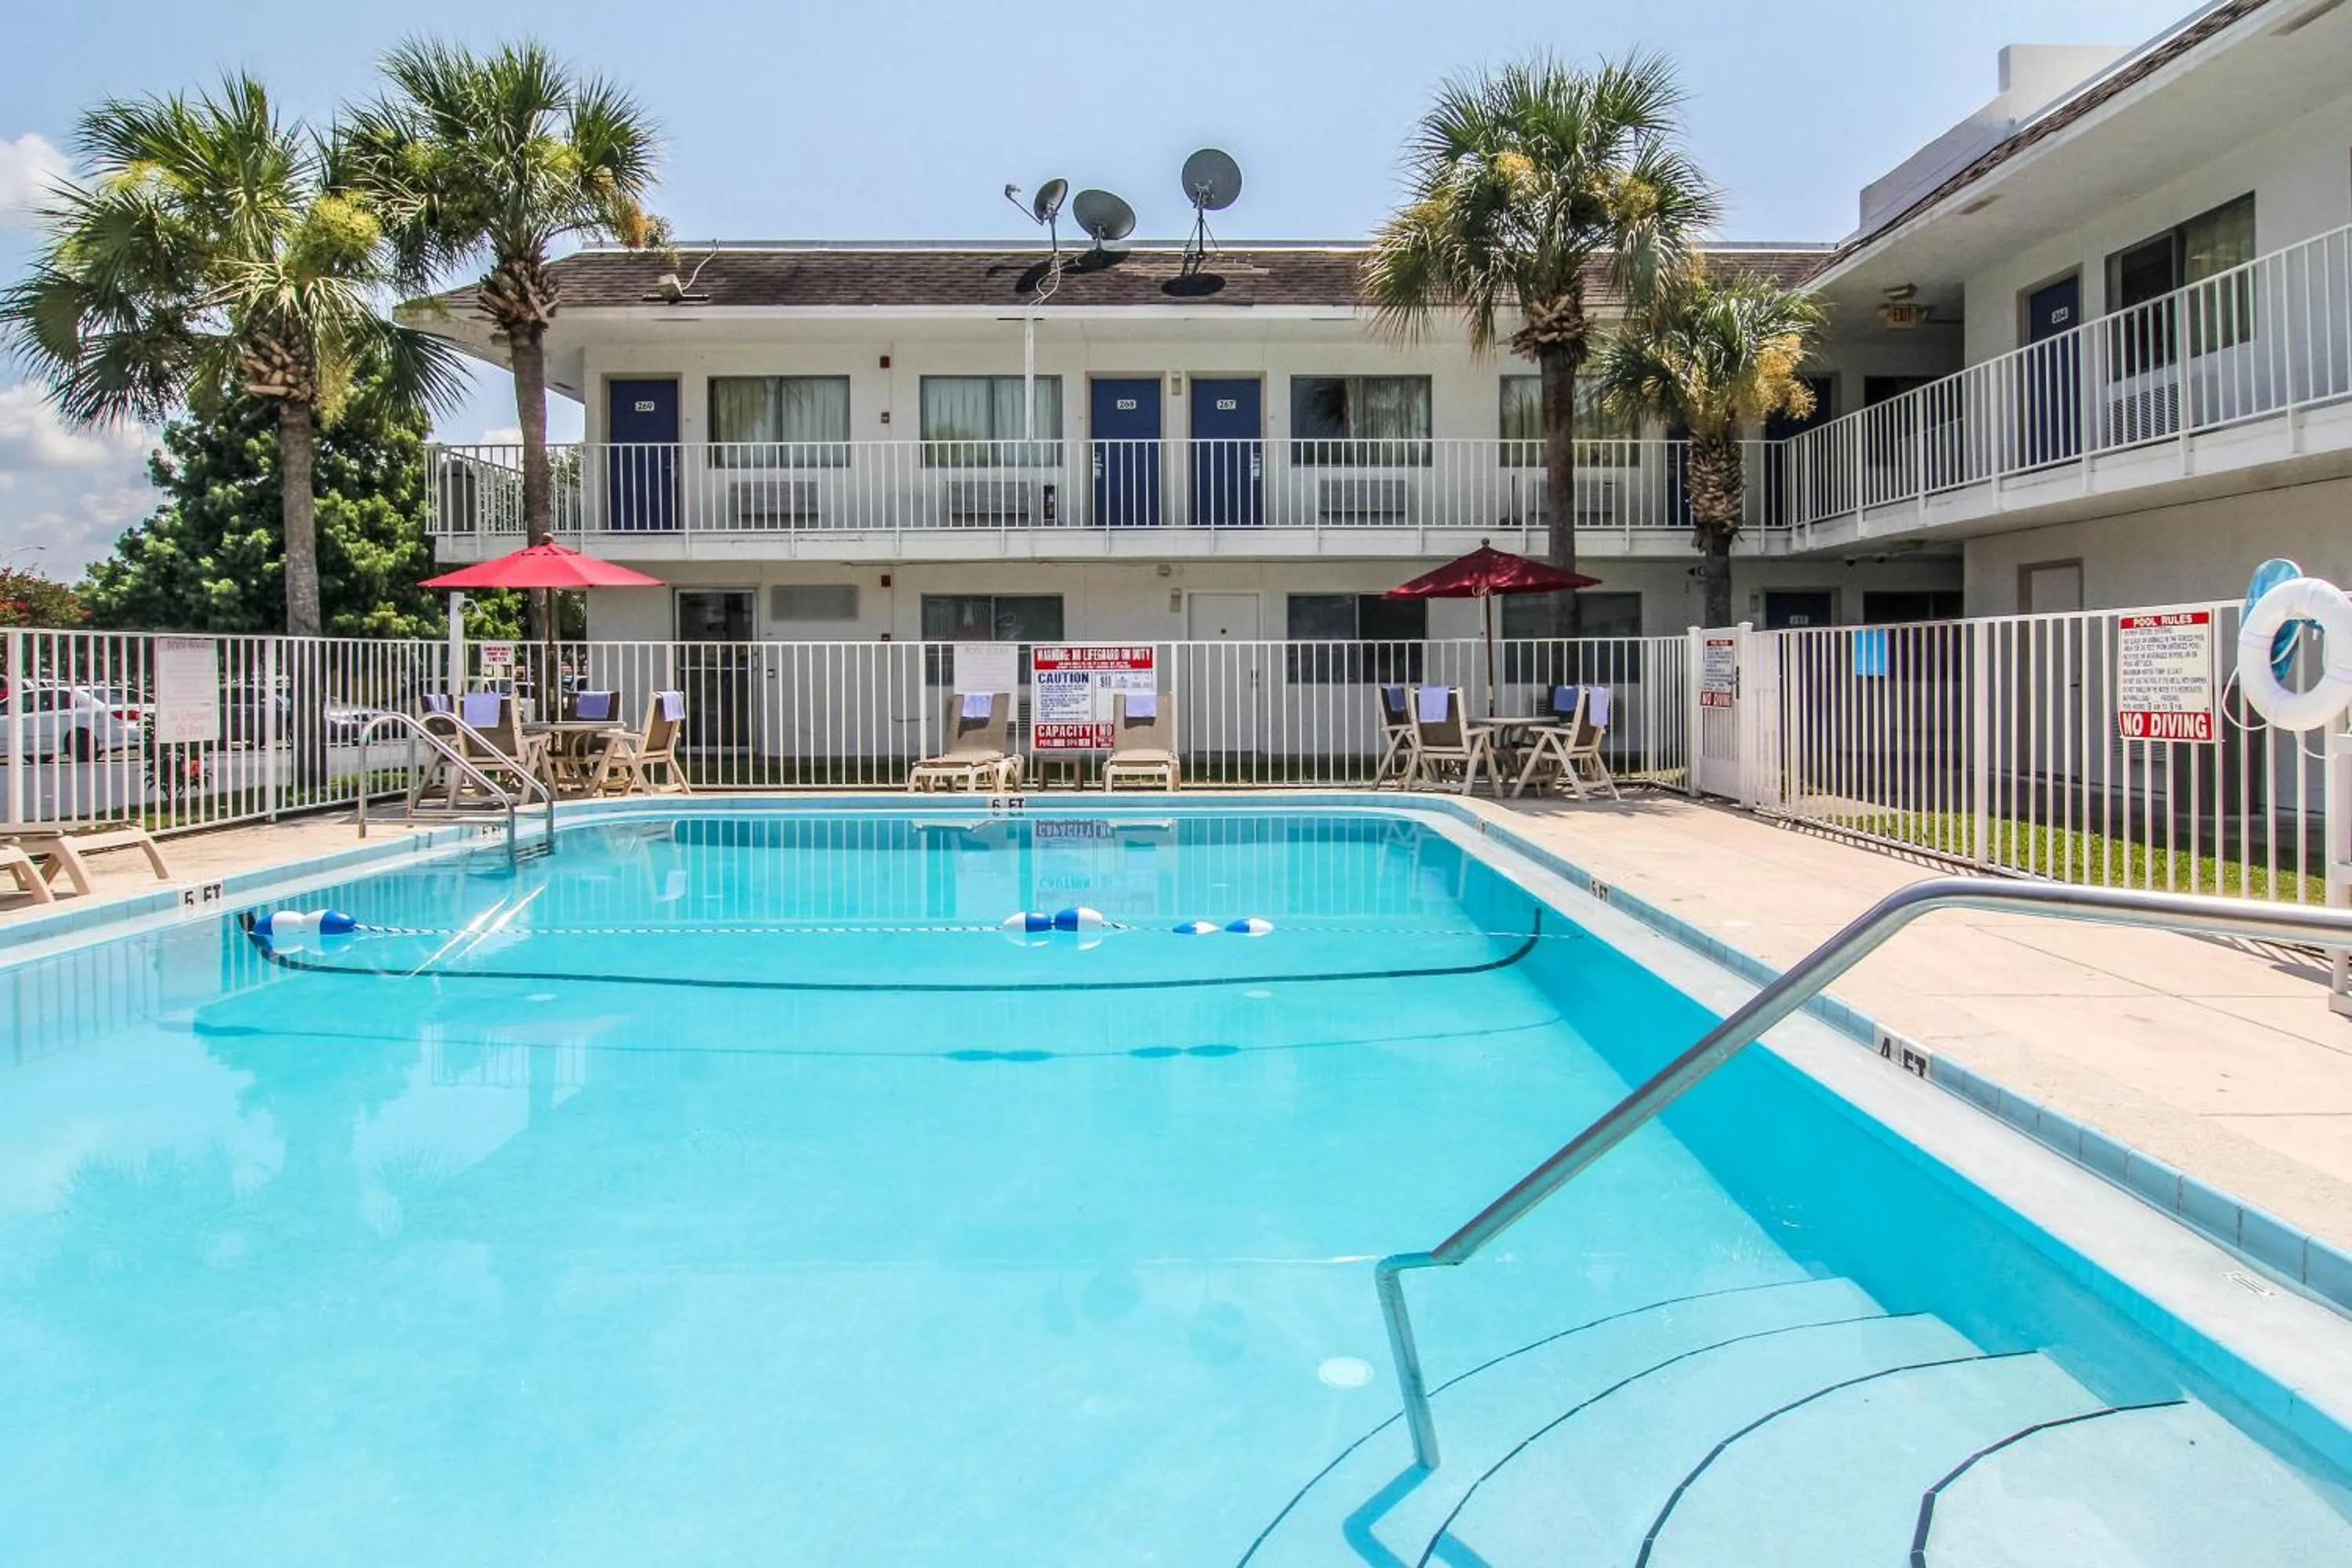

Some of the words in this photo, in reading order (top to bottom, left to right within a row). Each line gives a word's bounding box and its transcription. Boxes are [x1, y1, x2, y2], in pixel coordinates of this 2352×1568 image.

[2133, 616, 2158, 627] POOL
[2161, 614, 2192, 625] RULES
[1038, 672, 1089, 684] CAUTION
[1038, 725, 1091, 737] CAPACITY
[2123, 713, 2143, 735] NO
[2151, 713, 2207, 739] DIVING
[1008, 797, 1025, 808] FT
[204, 884, 221, 902] FT
[1903, 1048, 1926, 1077] FT
